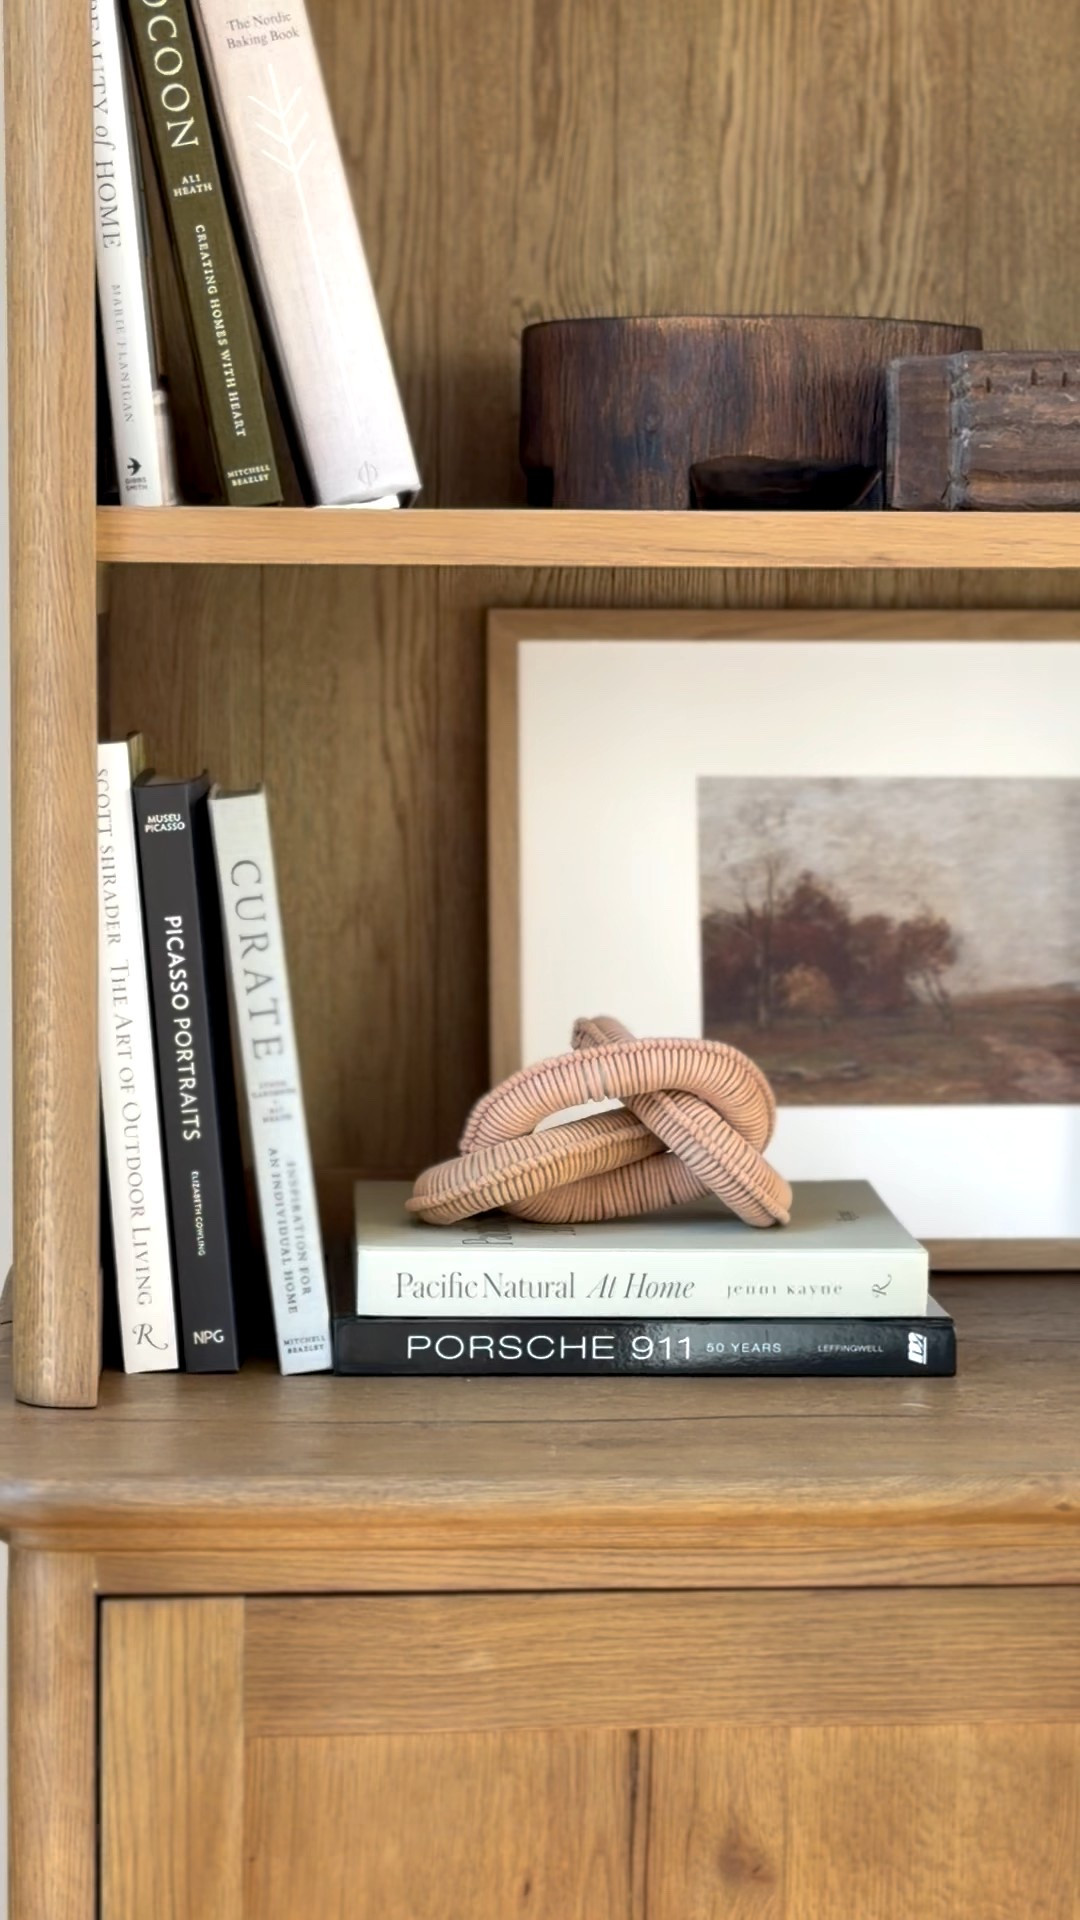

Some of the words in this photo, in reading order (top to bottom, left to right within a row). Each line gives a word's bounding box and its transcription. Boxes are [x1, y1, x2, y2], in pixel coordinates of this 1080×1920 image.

[226, 16, 251, 32] The
[252, 12, 292, 29] Nordic
[226, 33, 269, 50] Baking
[271, 26, 301, 42] Book
[143, 0, 199, 148] COON
[94, 125, 117, 151] of
[173, 182, 213, 197] HEATH
[181, 174, 201, 185] ALI
[95, 160, 121, 249] HOME
[195, 224, 218, 295] CREATING
[210, 298, 228, 346] HOMES
[220, 349, 236, 389] WITH
[228, 391, 247, 437] HEART
[116, 342, 134, 422] FLANIGAN
[227, 464, 271, 479] MITCHELL
[232, 473, 270, 487] BEAZLEY
[97, 768, 113, 837] SCOTT
[147, 813, 181, 824] MUSEU
[144, 821, 186, 833] PICASSO
[100, 845, 122, 946] SHRADER
[164, 915, 189, 1010] PICASSO
[230, 859, 285, 1060] CURATE
[114, 1012, 133, 1060] ART
[118, 1066, 136, 1093] OF
[172, 1017, 201, 1141] PORTRAITS
[121, 1101, 145, 1219] OUTDOOR
[268, 1147, 280, 1168] AN
[191, 1170, 203, 1215] ELIZABETH
[194, 1216, 207, 1256] COWLING
[270, 1172, 292, 1266] INDIVIDUAL
[285, 1161, 308, 1263] INSPIRATION
[298, 1266, 312, 1295] FOR
[132, 1226, 153, 1306] LIVING
[396, 1271, 478, 1299] Pacific
[482, 1272, 576, 1299] Natural
[585, 1272, 617, 1299] At
[623, 1272, 697, 1299] Home
[283, 1270, 299, 1315] HOME
[193, 1329, 224, 1345] NPG
[283, 1334, 326, 1347] MITCHELL
[406, 1334, 616, 1361] PORSCHE
[631, 1334, 692, 1361] 911
[705, 1342, 725, 1354] 50
[731, 1342, 783, 1354] YEARS
[817, 1344, 885, 1353] LEFFINGWELL
